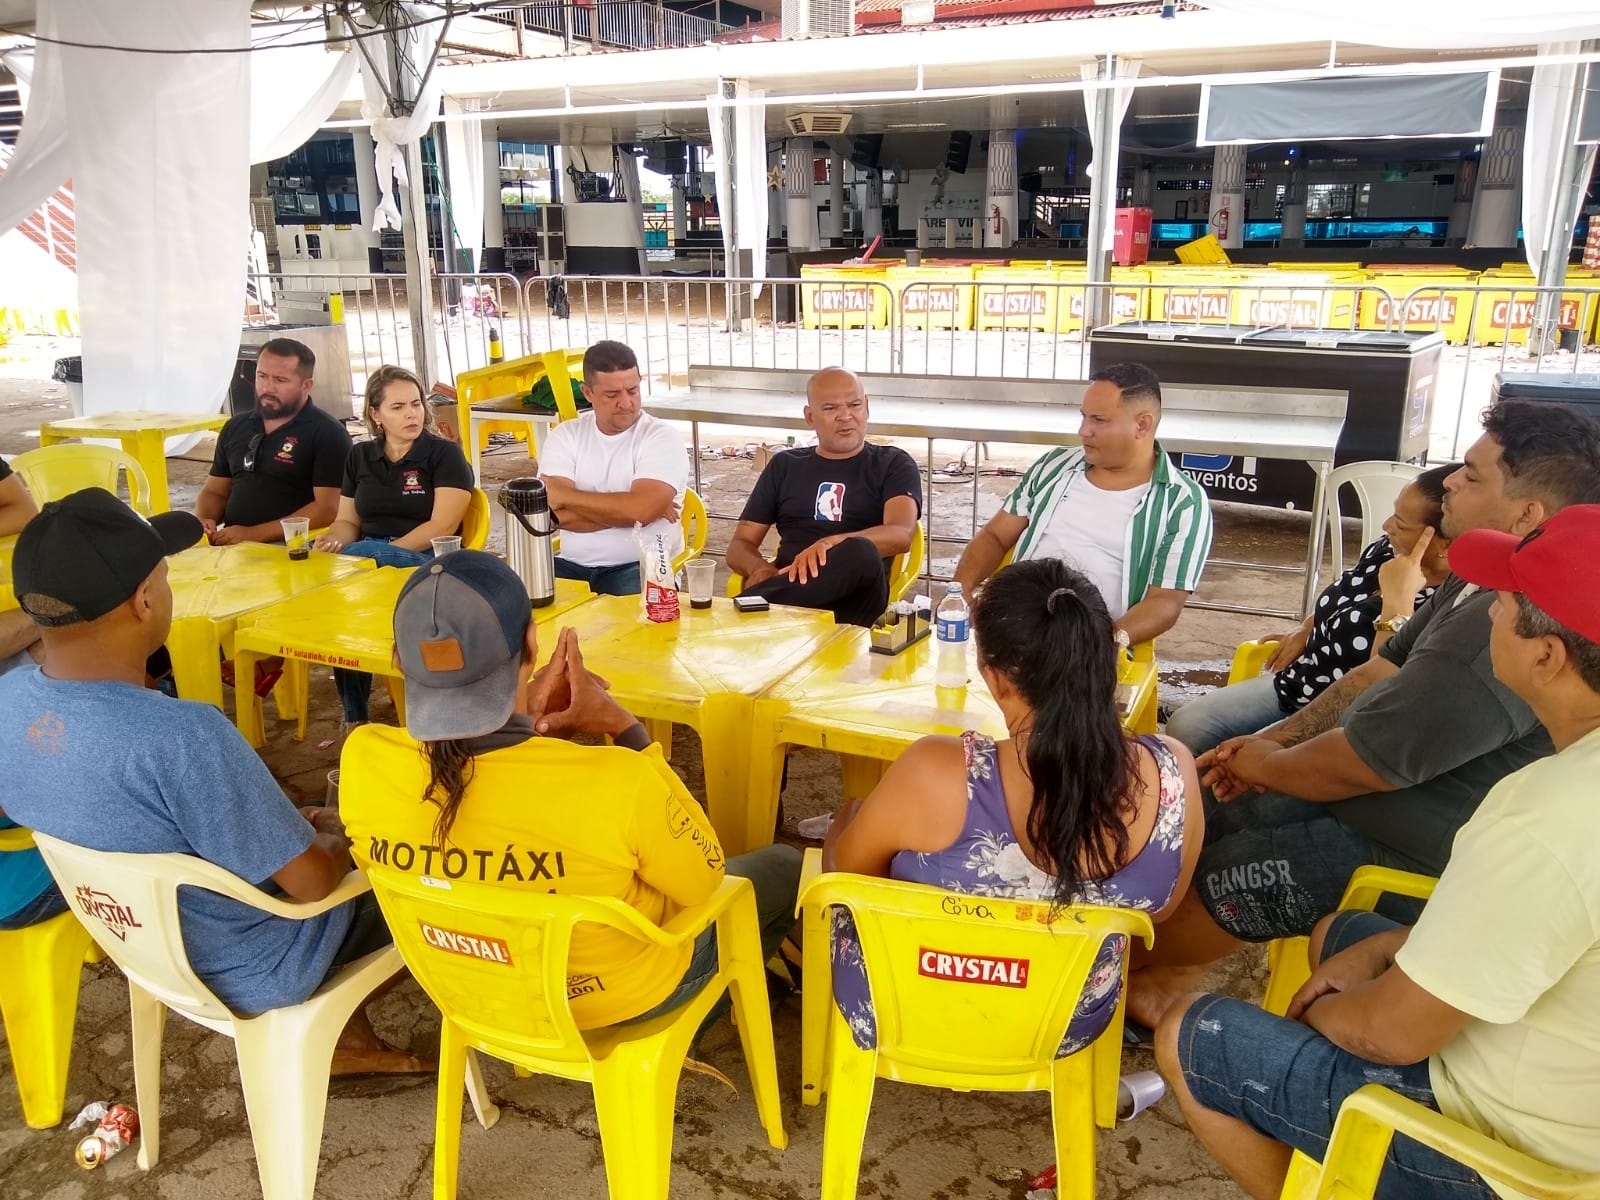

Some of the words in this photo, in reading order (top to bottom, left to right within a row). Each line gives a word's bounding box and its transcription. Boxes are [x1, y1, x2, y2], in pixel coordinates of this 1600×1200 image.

[1165, 295, 1229, 318] CRYSTAL
[1493, 300, 1573, 326] CRYSL
[370, 836, 565, 882] MOTOTÁXI
[1206, 859, 1297, 900] GANGSR
[75, 894, 143, 928] CRYSTAL
[422, 924, 509, 963] CRYSTAL
[921, 951, 1022, 984] CRYSTAL
